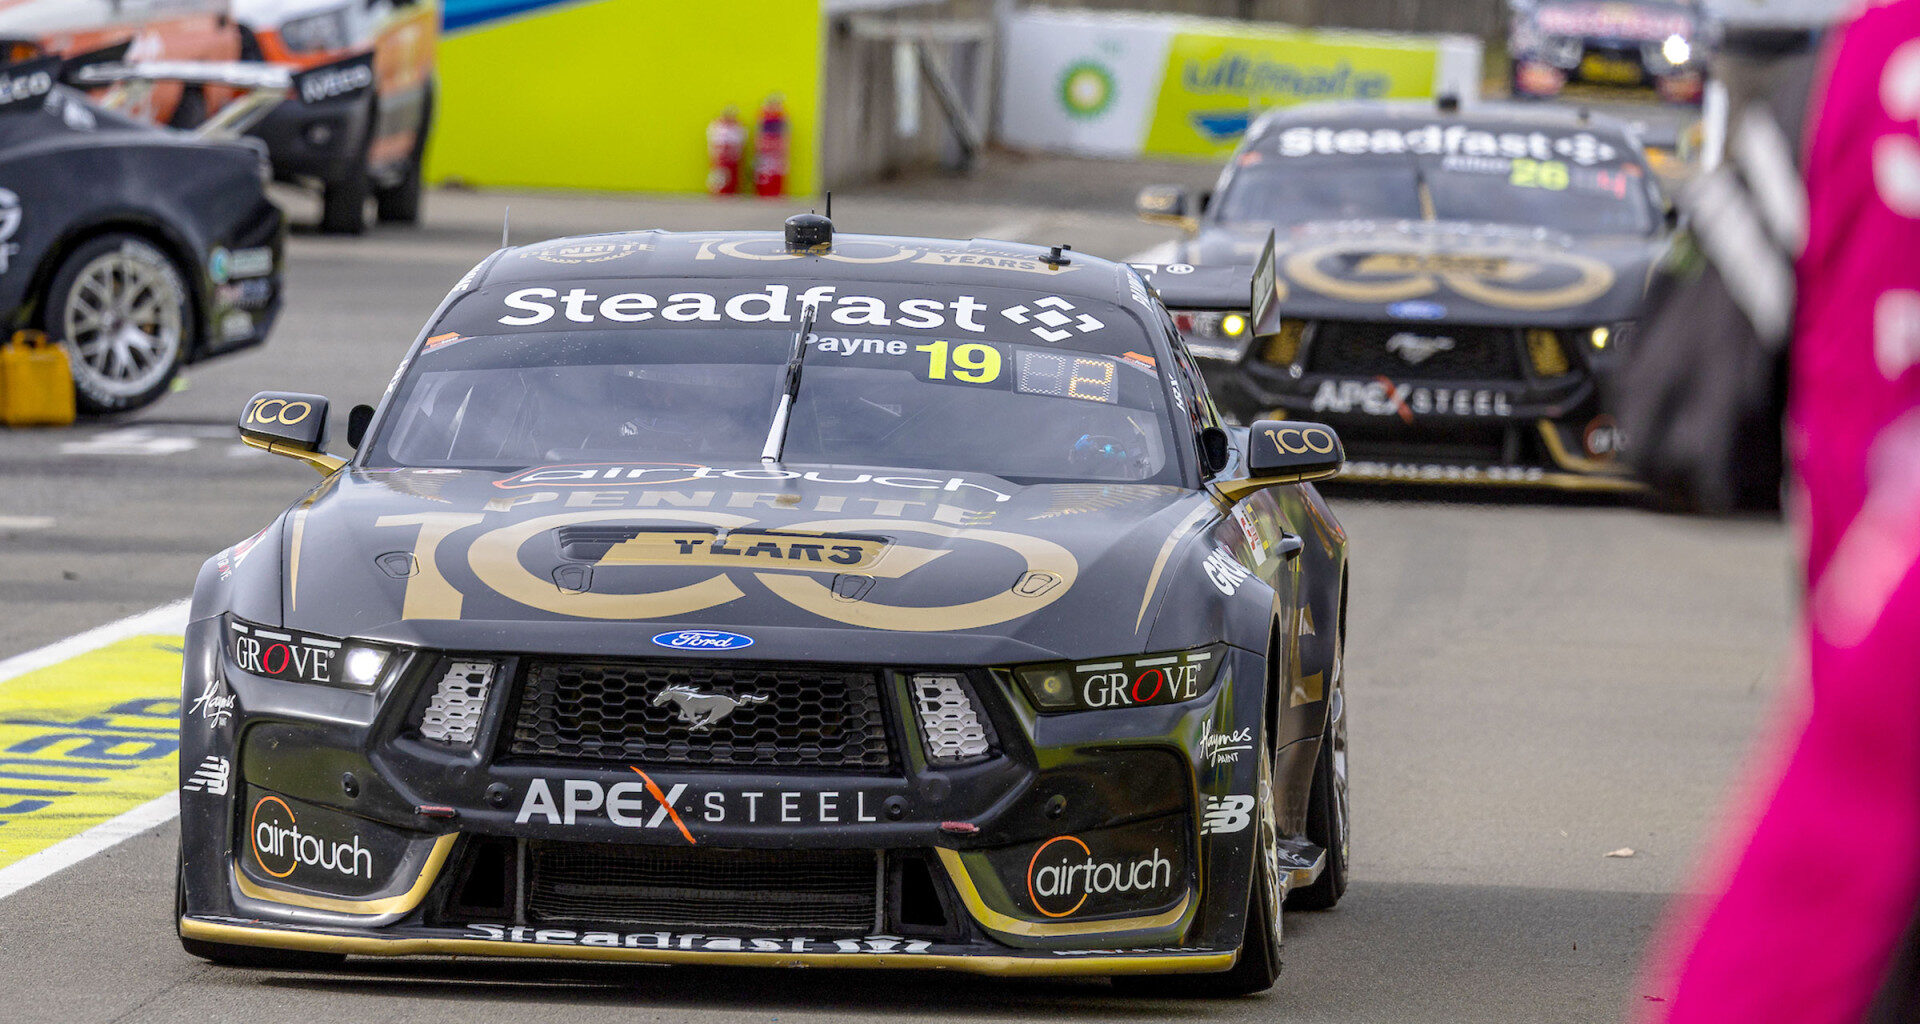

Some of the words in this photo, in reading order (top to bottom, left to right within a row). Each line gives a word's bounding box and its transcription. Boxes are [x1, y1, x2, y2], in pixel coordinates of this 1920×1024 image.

[1279, 124, 1554, 161] Steadfast
[938, 254, 1036, 271] YEARS
[497, 284, 988, 332] Steadfast
[794, 332, 908, 356] Payne
[915, 340, 1002, 384] 19
[246, 398, 312, 426] 100
[1310, 378, 1414, 425] APEX
[1411, 387, 1512, 417] STEEL
[1264, 428, 1335, 455] 100
[519, 465, 1012, 503] airtouch
[483, 490, 997, 526] PENRITE
[374, 509, 1079, 632] 100
[671, 632, 735, 647] Ford
[1199, 718, 1252, 768] Haymes
[1216, 752, 1239, 764] PAINT
[514, 767, 696, 844] APEX
[703, 791, 877, 823] STEEL
[256, 819, 373, 879] airtouch
[1035, 847, 1171, 897] airtouch
[463, 923, 815, 953] Steadfast
